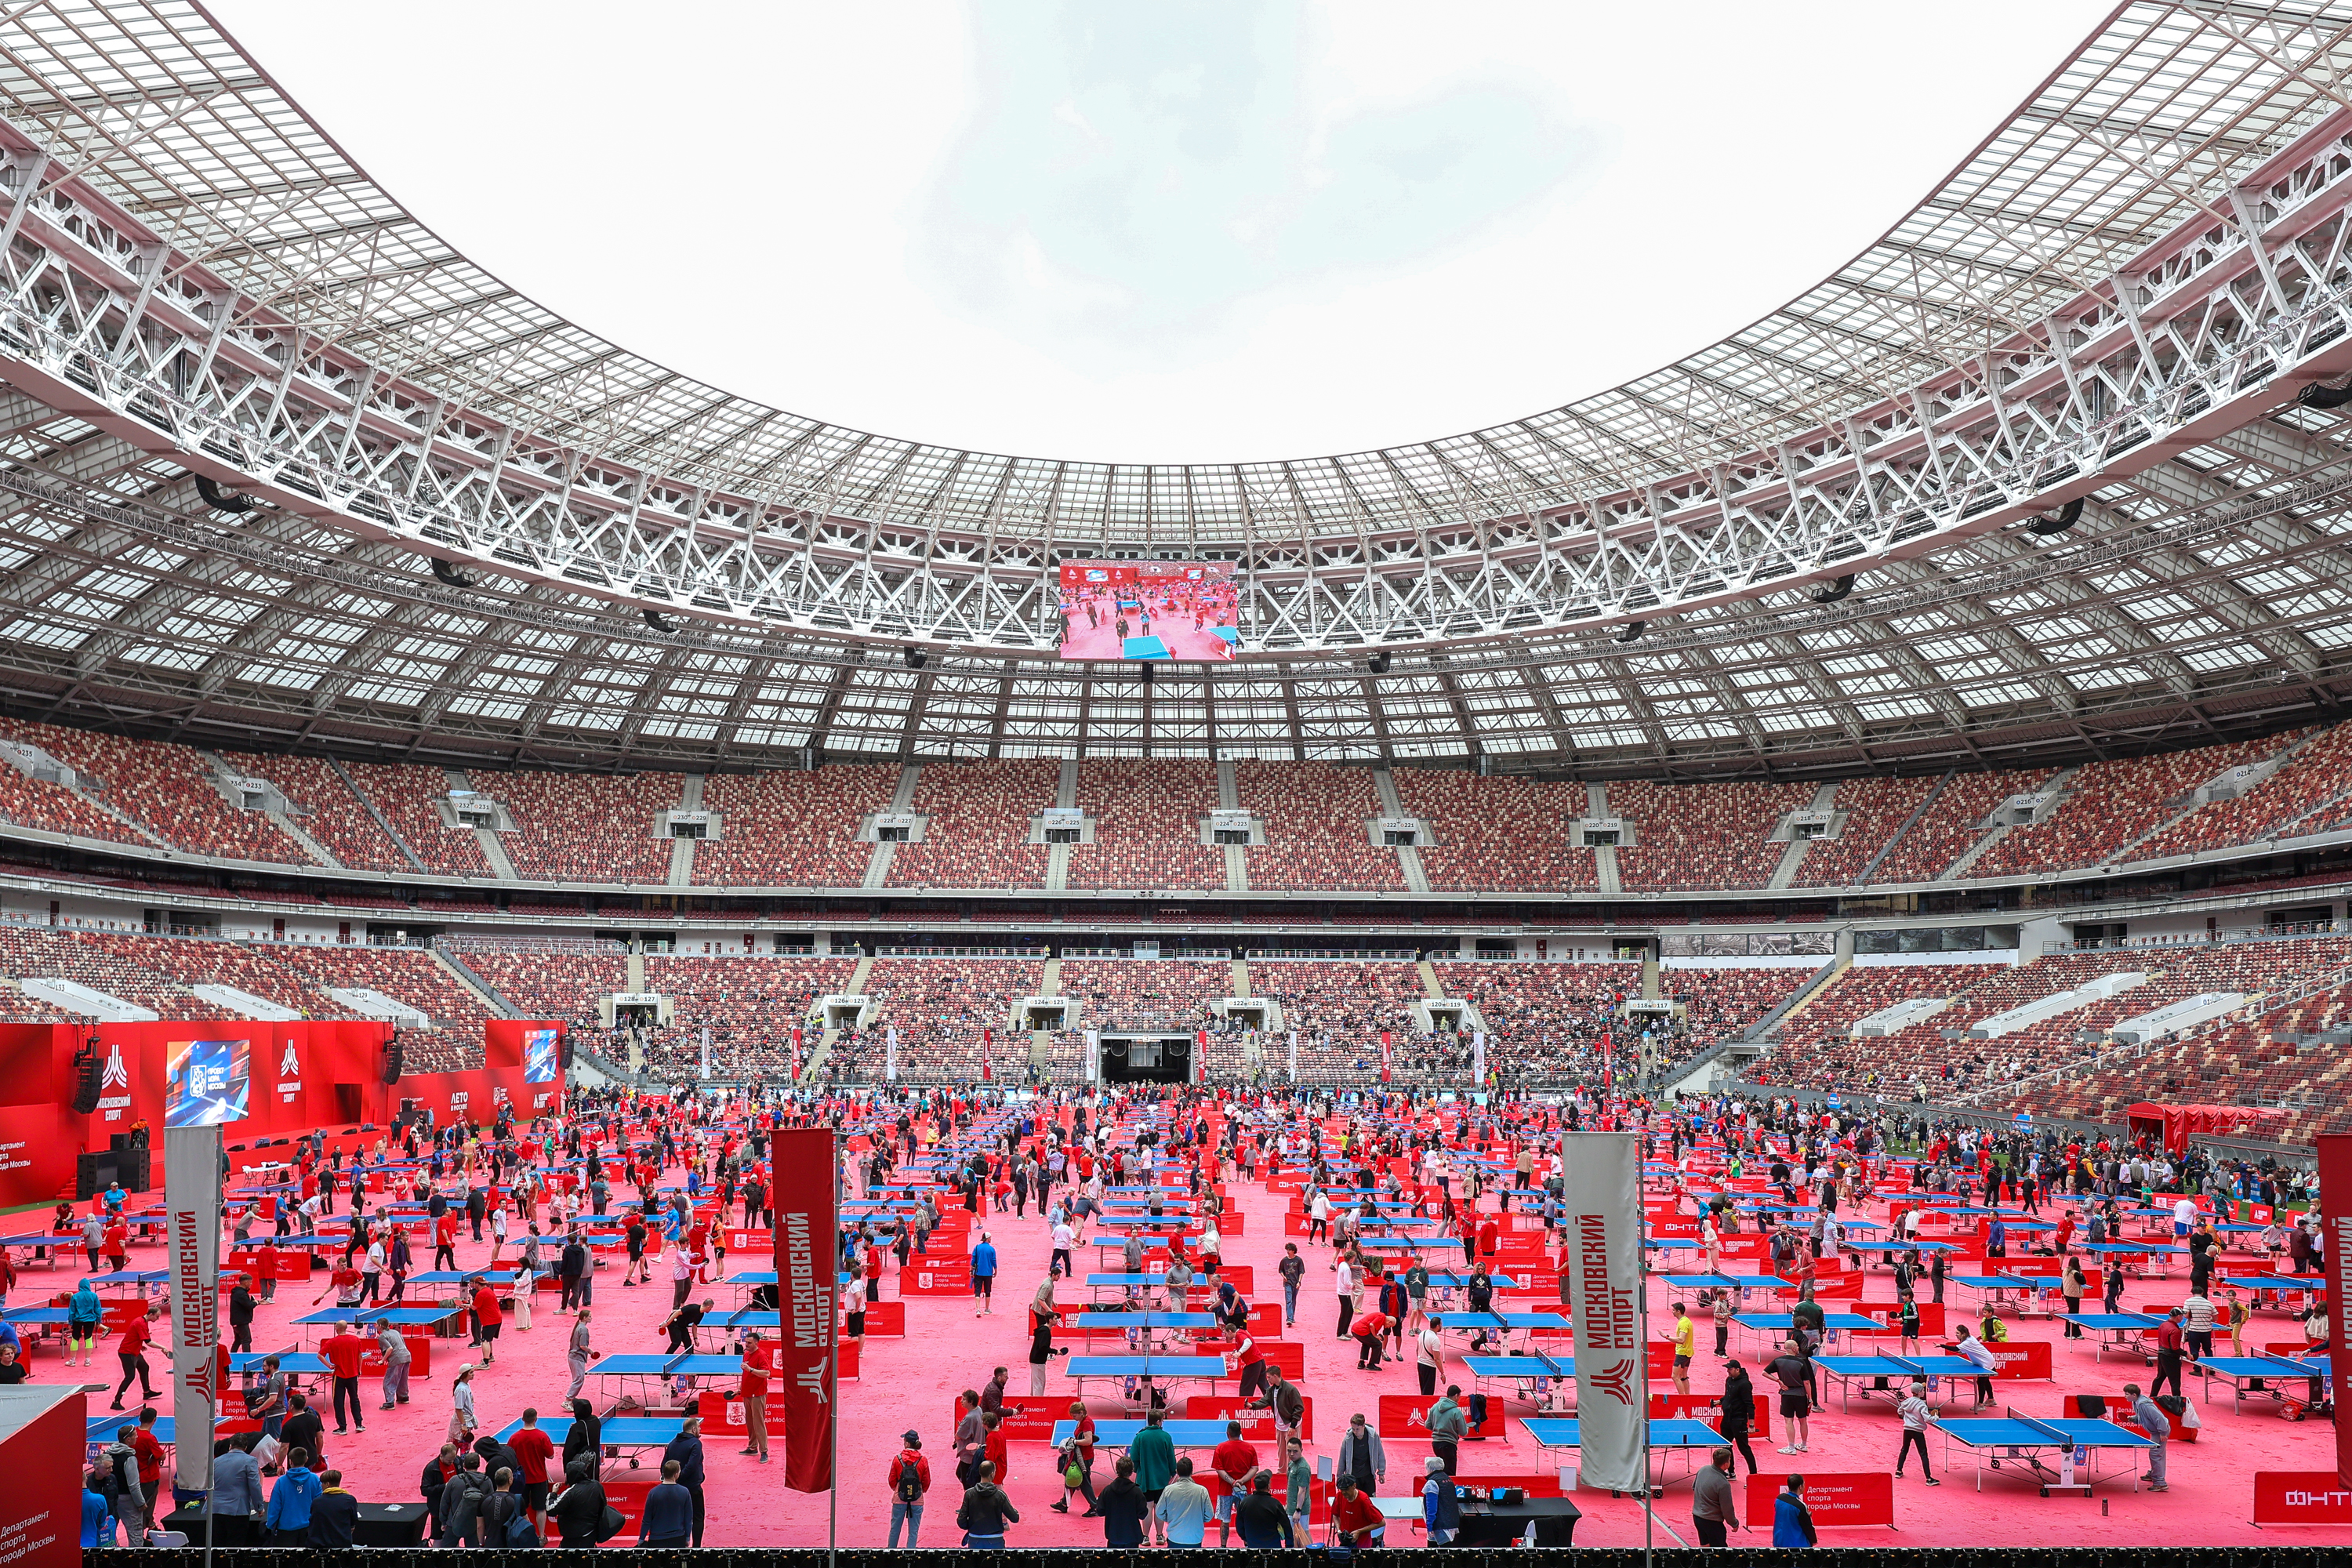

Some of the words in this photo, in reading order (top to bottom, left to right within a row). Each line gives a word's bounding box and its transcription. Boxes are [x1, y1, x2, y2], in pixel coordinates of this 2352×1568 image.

[208, 1082, 227, 1091] МОСКВЫ
[278, 1080, 301, 1093] МОСКОВСКИЙ
[283, 1093, 296, 1104] СПОРТ
[451, 1091, 468, 1104] ЛЕТО
[105, 1109, 122, 1121] СПОРТ
[9, 1159, 31, 1169] Москвы
[174, 1210, 201, 1348] МОСКОВСКИЙ
[782, 1212, 817, 1347] МОСКОВСКИЙ
[1575, 1214, 1612, 1348] МОСКОВСКИЙ
[201, 1283, 214, 1348] СПОРТ
[815, 1283, 832, 1347] СПОРТ
[1611, 1287, 1633, 1348] СПОРТ
[1992, 1350, 2028, 1362] ОСКОВСКИЙ
[1994, 1361, 2006, 1370] ОРТ
[1234, 1409, 1275, 1418] МОСКОВСК
[1456, 1488, 1465, 1497] 2
[1476, 1488, 1485, 1498] 30
[1807, 1485, 1853, 1494] Департамент
[1807, 1494, 1831, 1502] спорта
[1807, 1501, 1831, 1511] города
[1, 1510, 49, 1539] Департамент
[0, 1533, 26, 1551] спорта
[0, 1547, 27, 1565] города
[27, 1534, 56, 1553] Москвы
